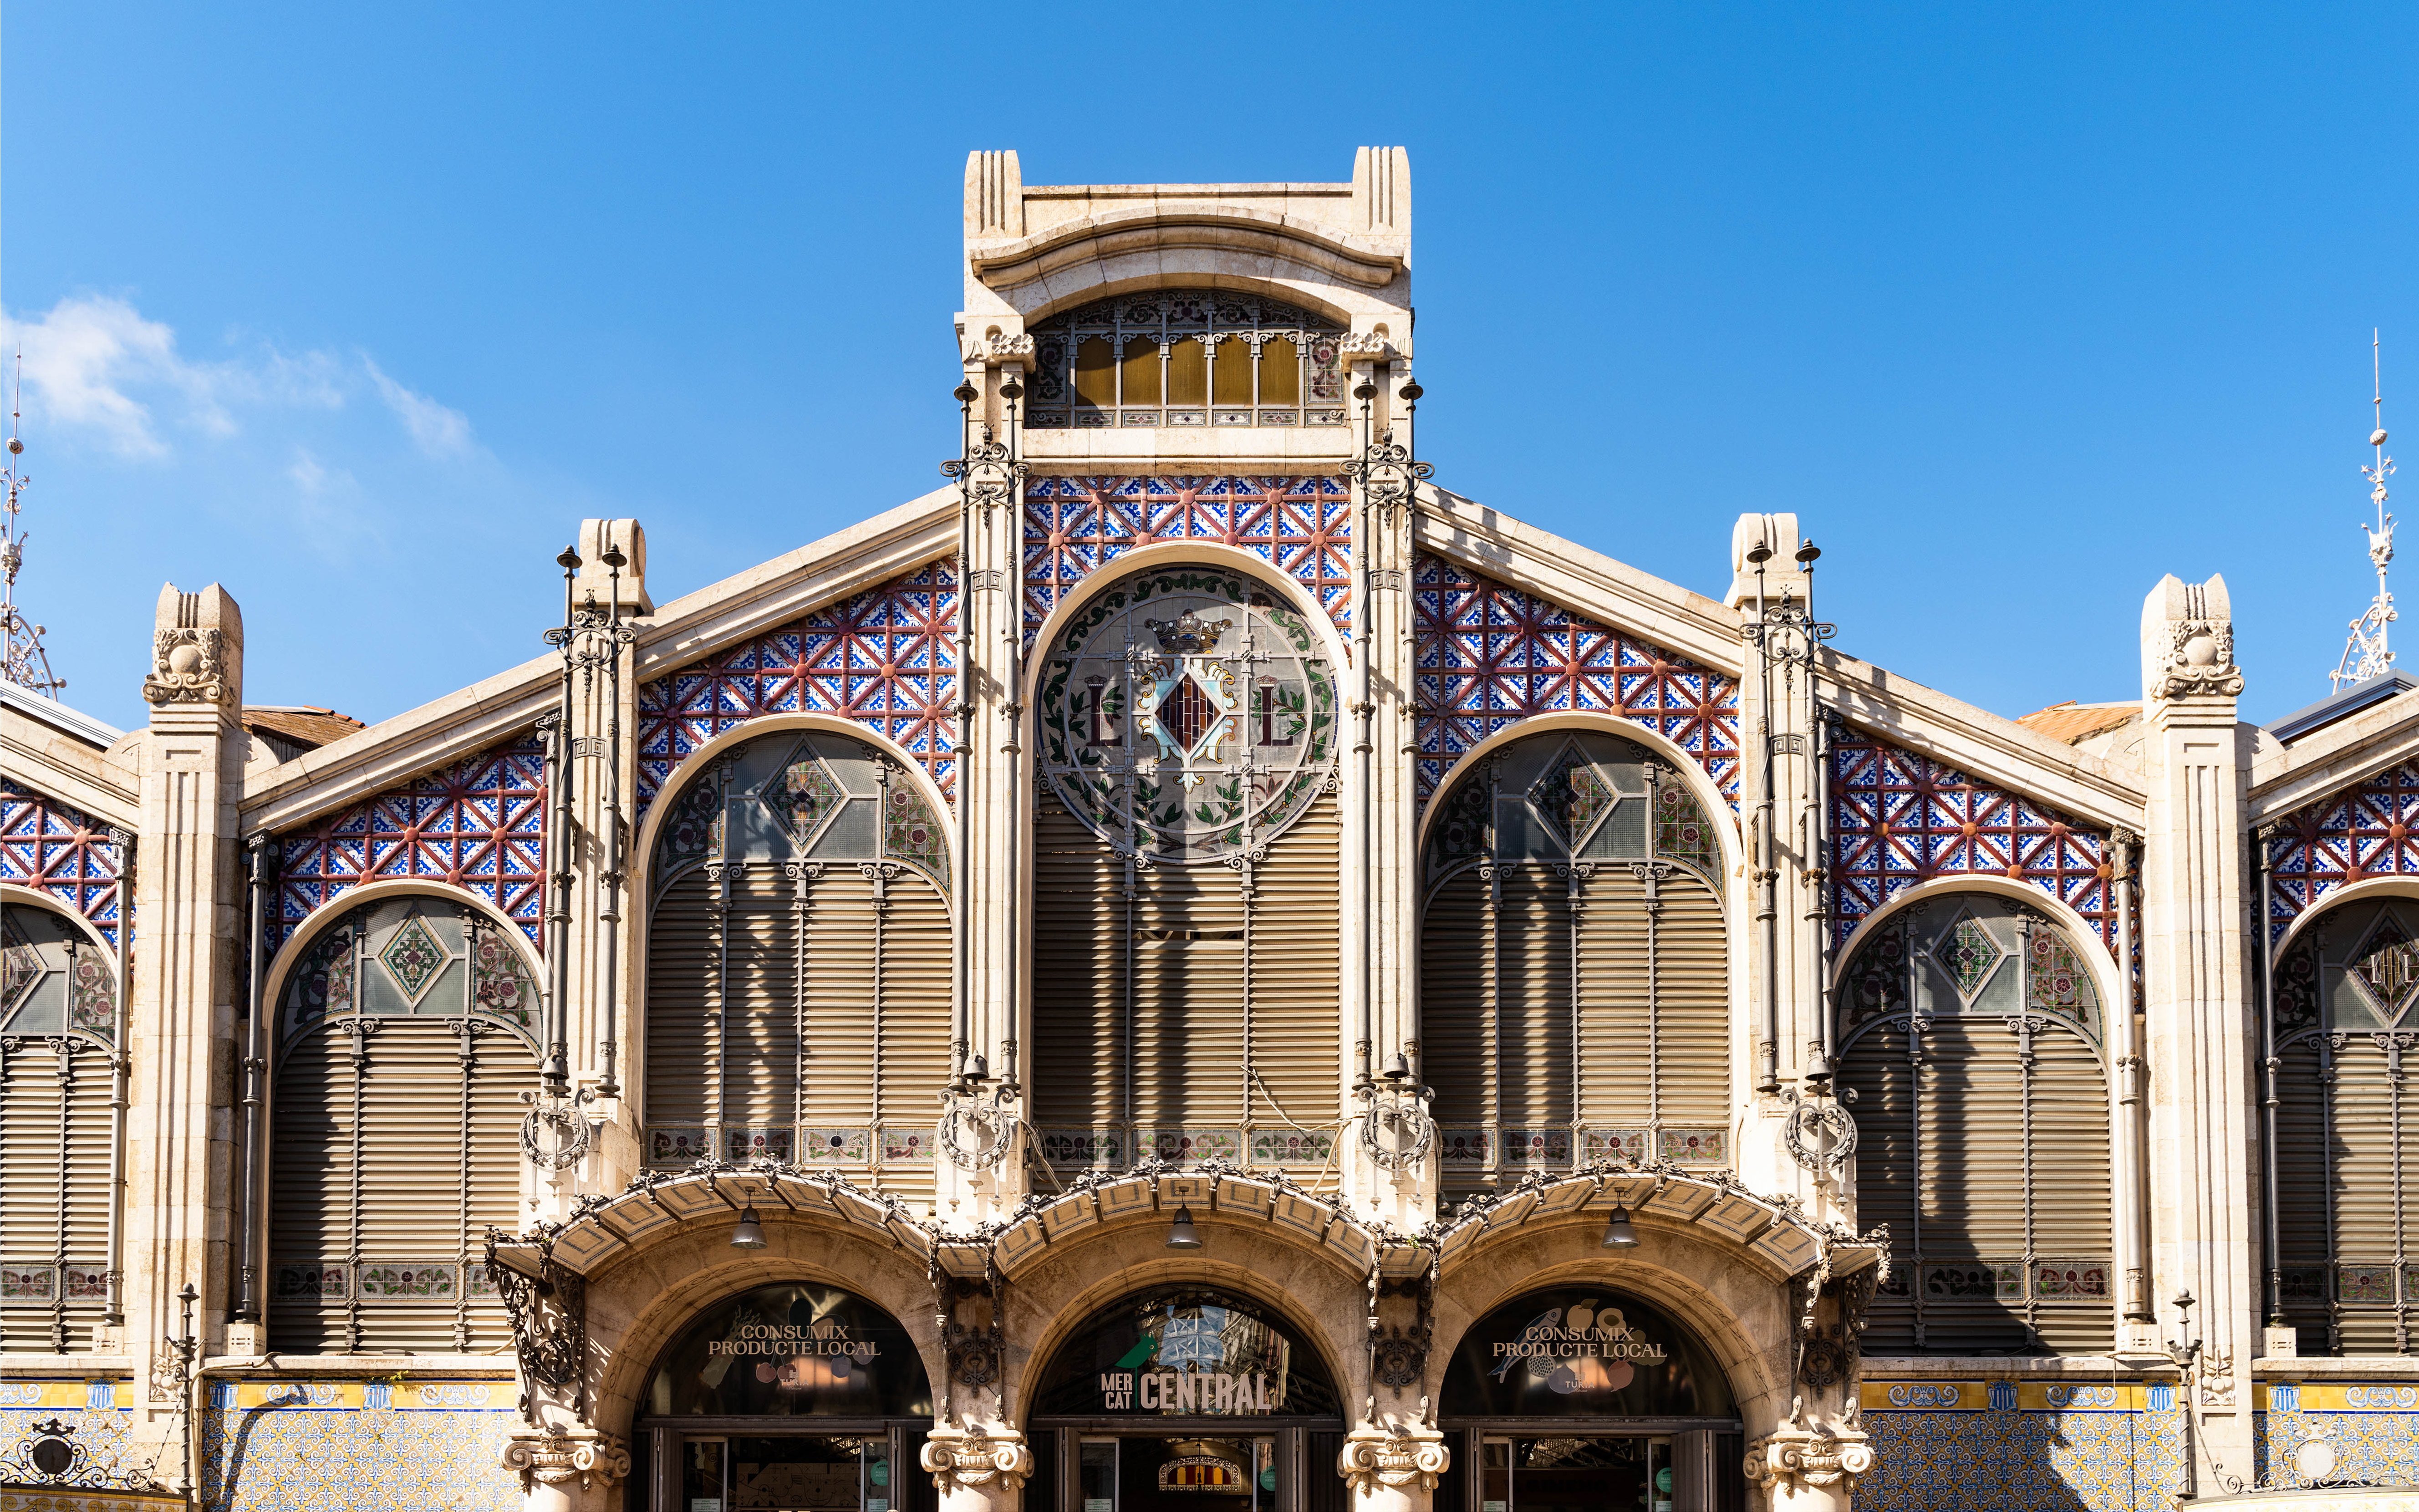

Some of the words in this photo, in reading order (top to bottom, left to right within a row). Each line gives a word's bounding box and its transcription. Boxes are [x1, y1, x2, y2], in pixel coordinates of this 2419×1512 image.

[741, 1325, 849, 1339] CONSUMIX
[1525, 1326, 1635, 1341] CONSUMIX
[708, 1341, 812, 1355] PRODUCTE
[817, 1341, 881, 1355] LOCAL
[1492, 1343, 1598, 1357] PRODUCTE
[1603, 1343, 1667, 1358] LOCAL
[1101, 1373, 1132, 1391] MER
[1141, 1373, 1272, 1410] CENTRAL
[1105, 1391, 1132, 1410] CAT
